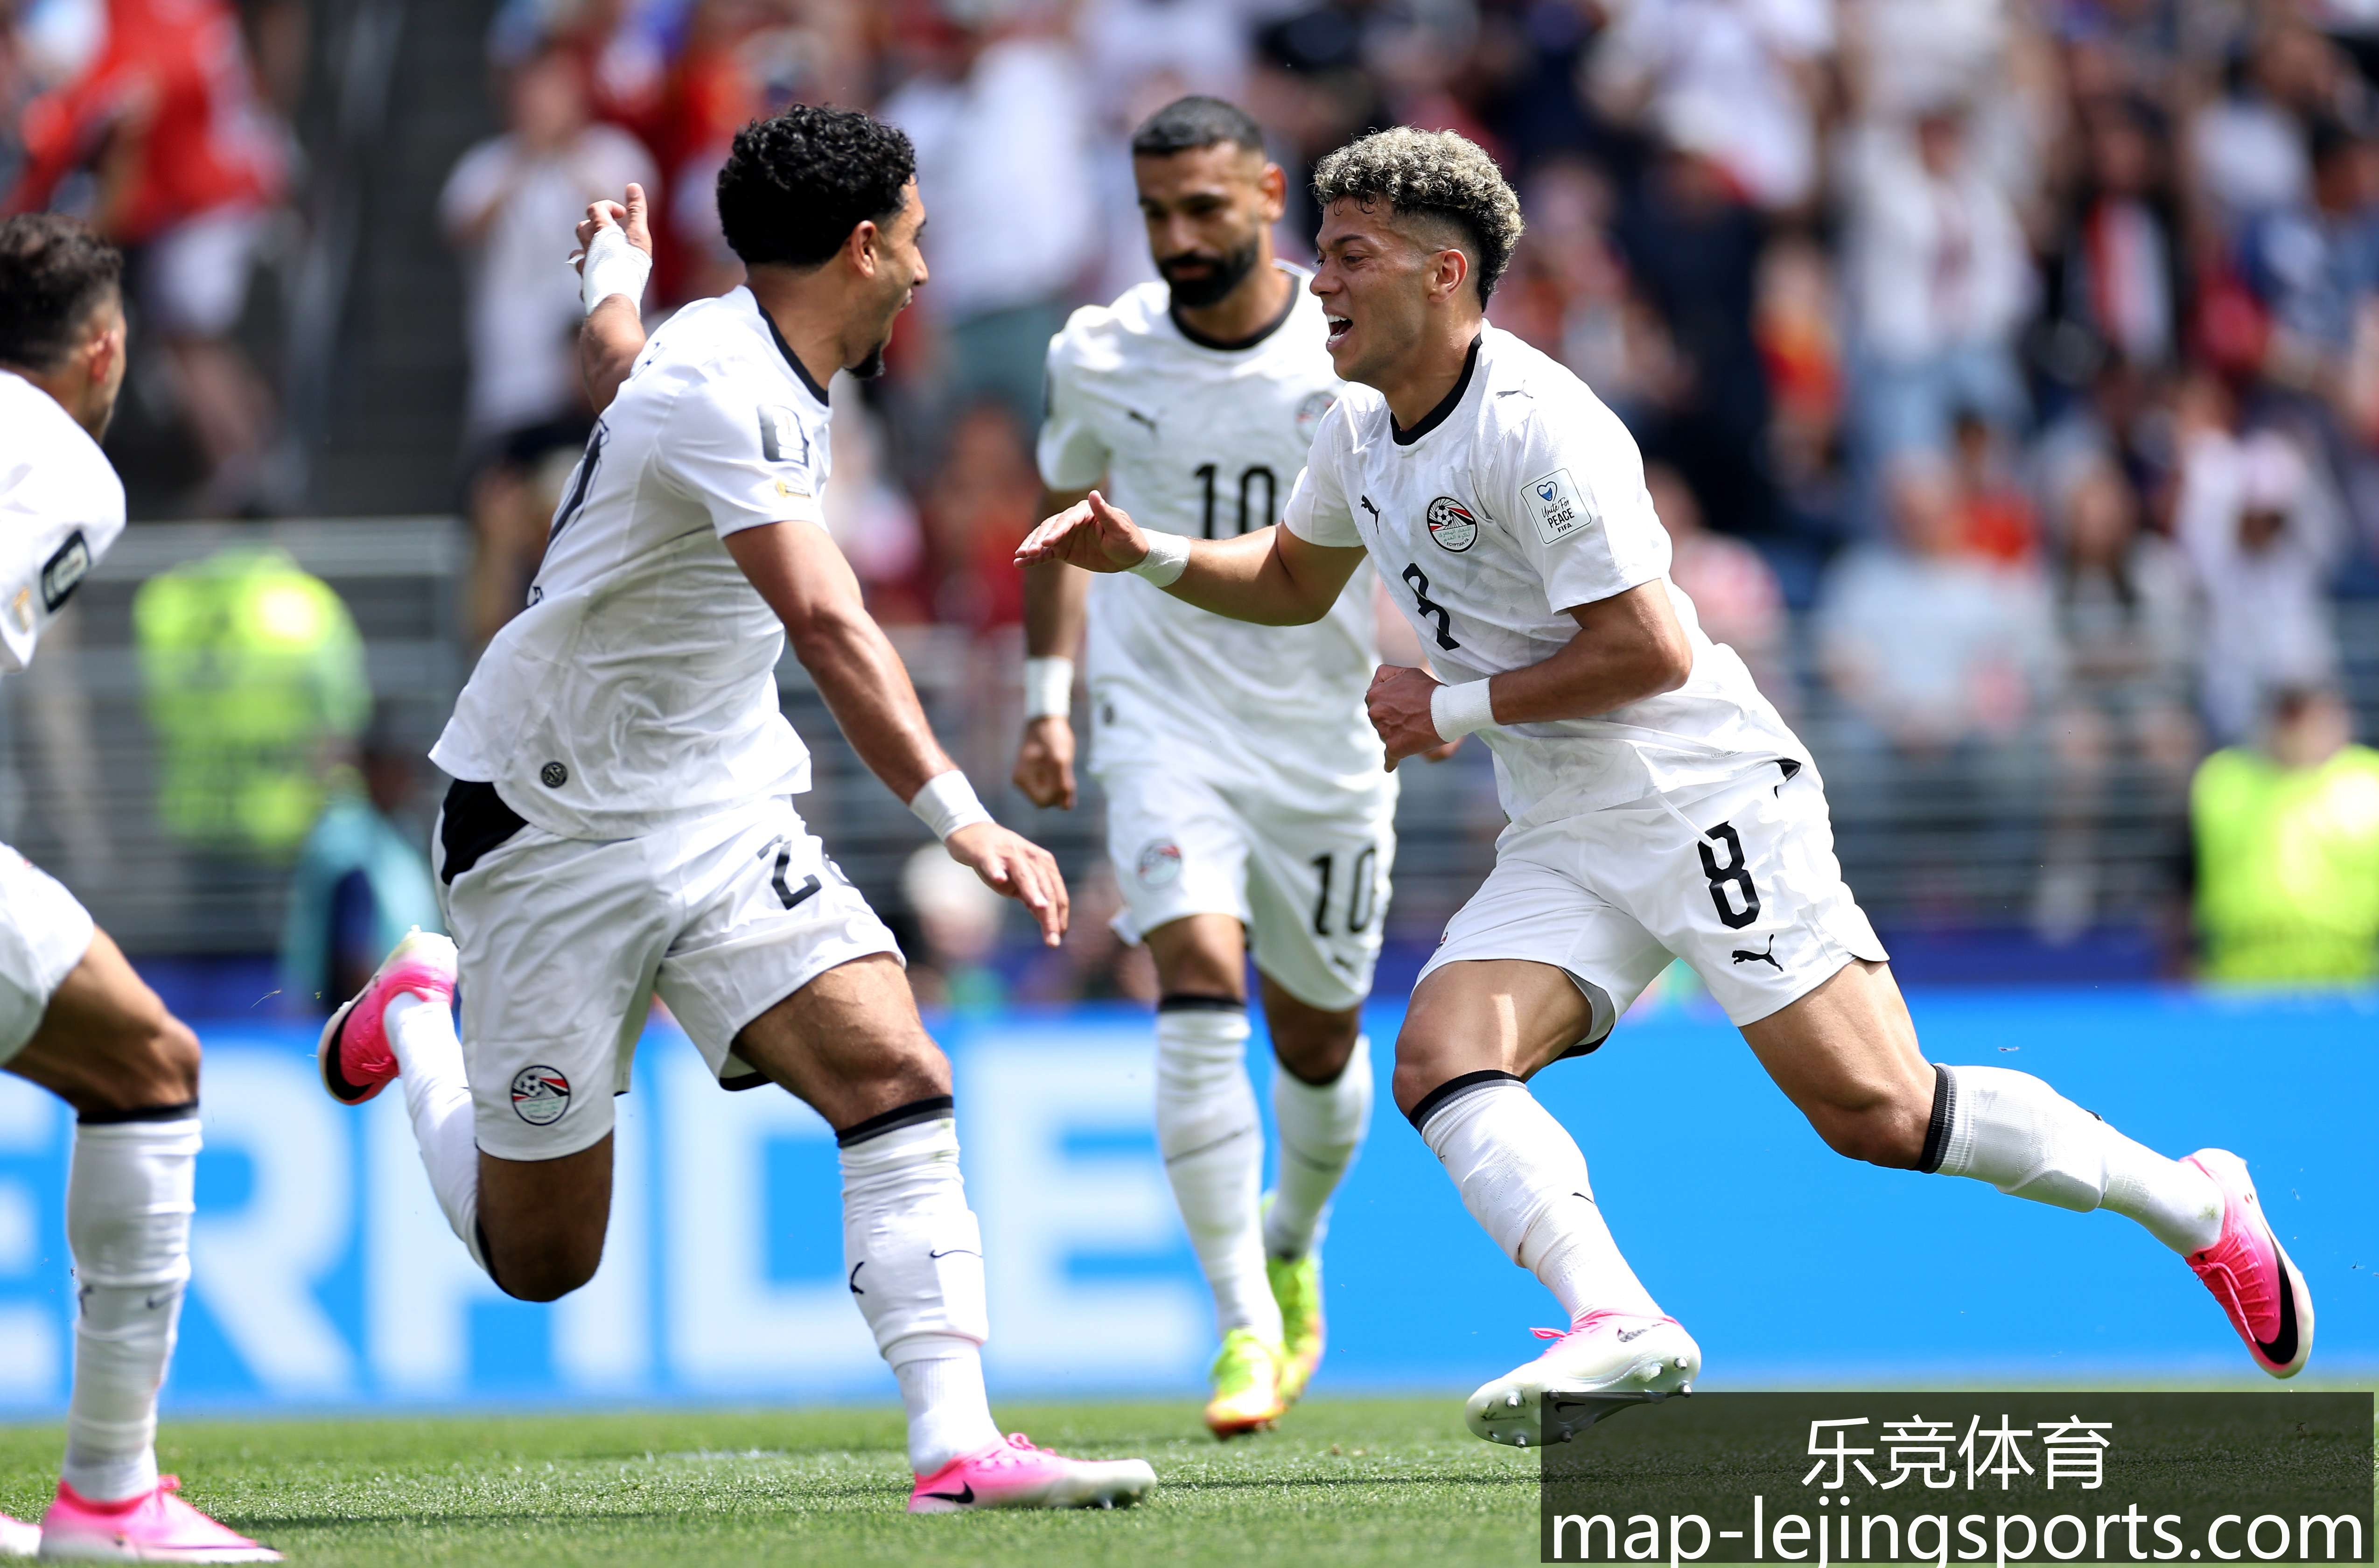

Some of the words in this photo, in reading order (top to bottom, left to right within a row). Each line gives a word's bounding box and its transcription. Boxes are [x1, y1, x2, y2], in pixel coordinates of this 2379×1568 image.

[1194, 463, 1276, 539] 10
[1541, 503, 1559, 518] Unite
[1558, 497, 1569, 510] For
[1547, 508, 1575, 528] PEACE
[1557, 523, 1572, 533] FIFA
[1402, 563, 1460, 651] 8
[1312, 845, 1377, 937] 10
[1697, 820, 1761, 930] 8
